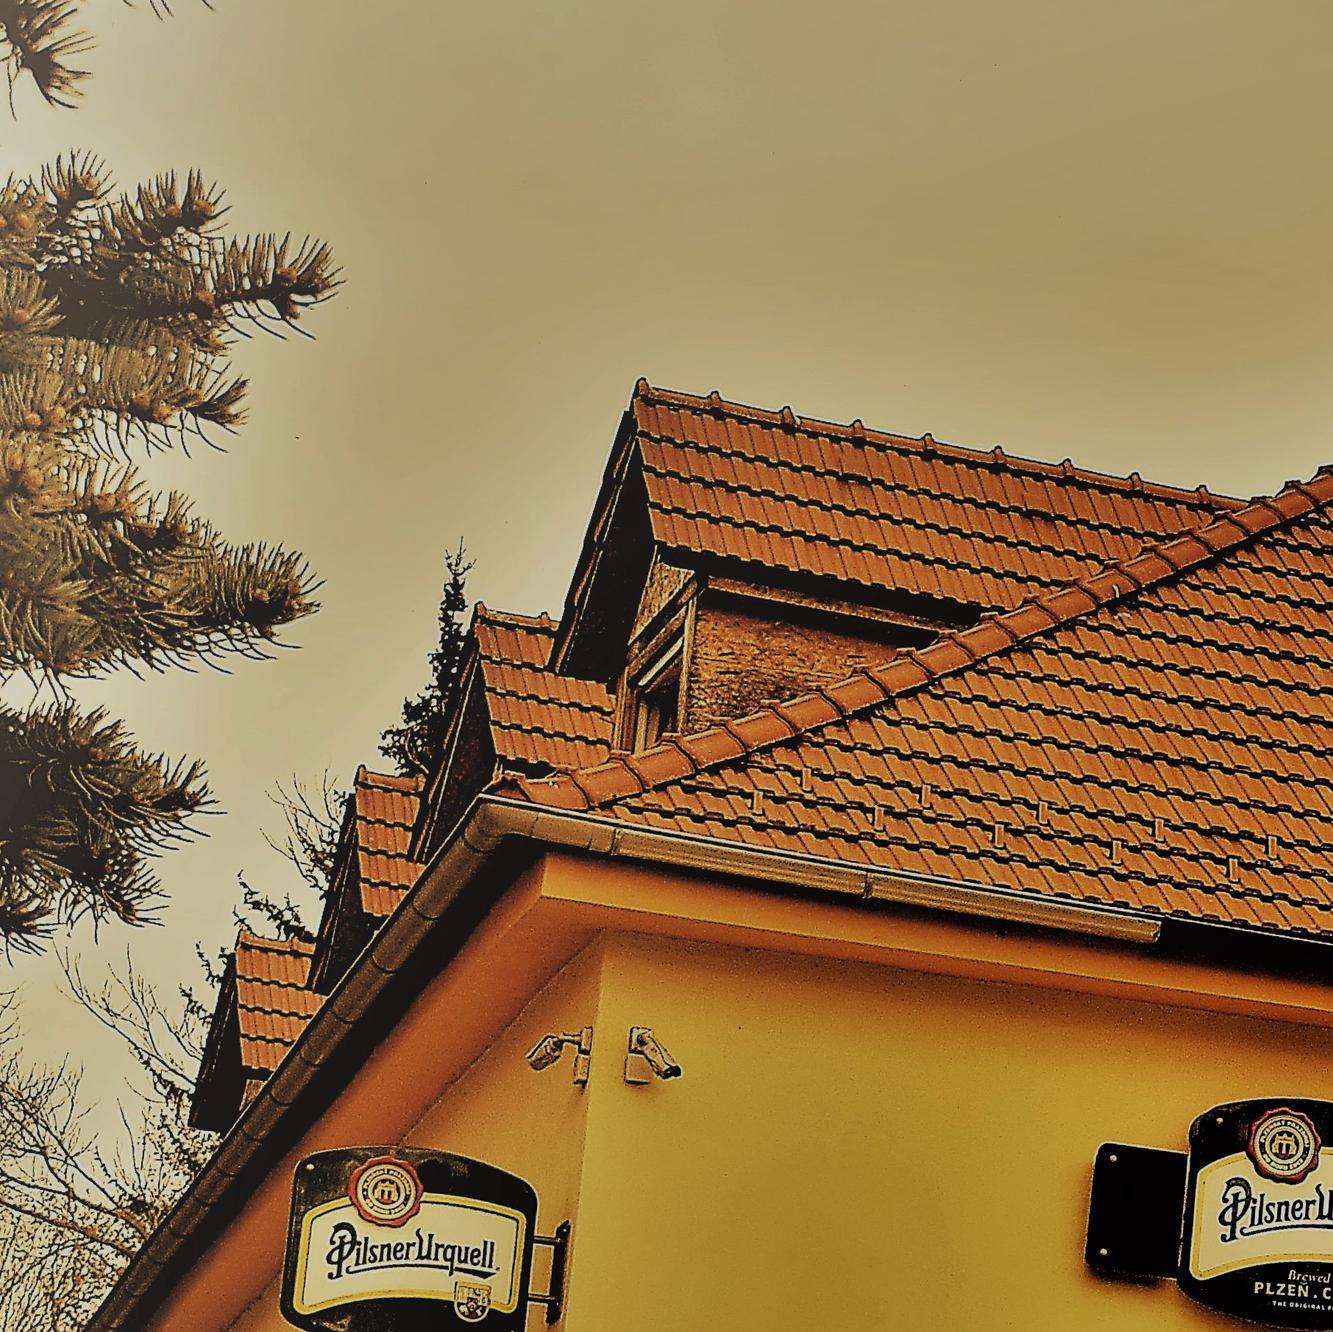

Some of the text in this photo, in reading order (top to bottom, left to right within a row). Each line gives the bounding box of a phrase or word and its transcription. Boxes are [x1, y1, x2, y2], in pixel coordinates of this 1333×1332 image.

[1219, 1177, 1315, 1243] Pilsner
[326, 1222, 495, 1280] Pilsner Urquell
[1254, 1282, 1309, 1297] PLZEŇ
[1288, 1270, 1331, 1284] Brewed
